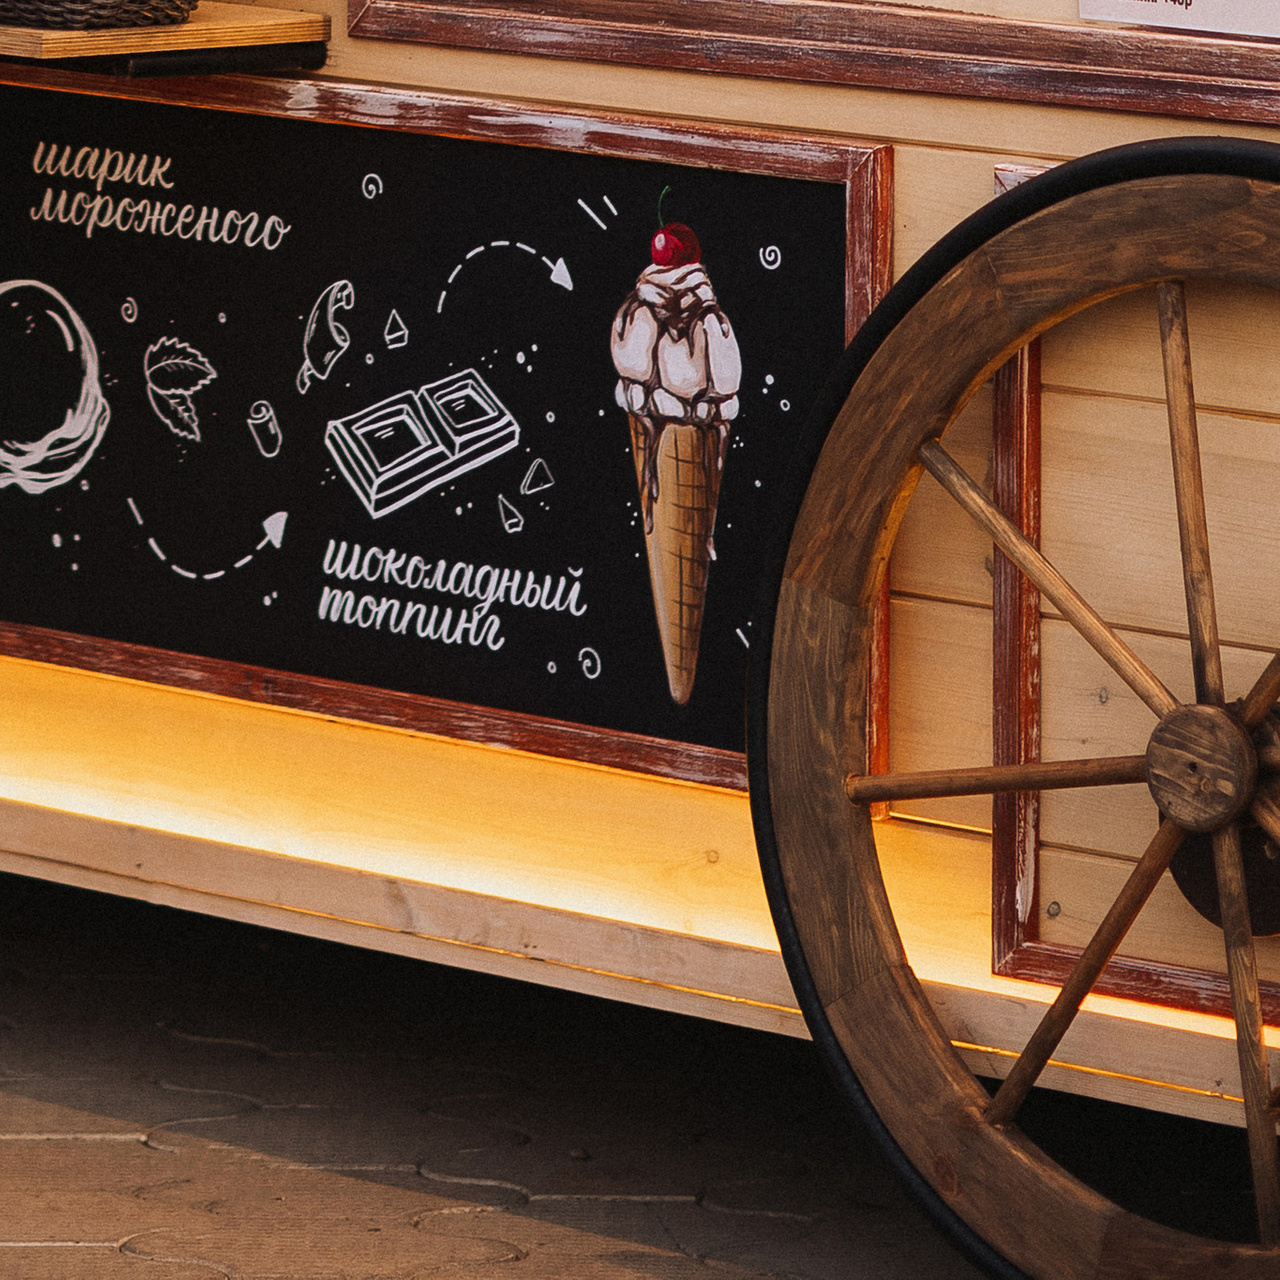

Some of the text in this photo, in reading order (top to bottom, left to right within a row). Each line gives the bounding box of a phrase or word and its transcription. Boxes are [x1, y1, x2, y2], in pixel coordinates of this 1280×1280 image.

[32, 141, 175, 192] шарик
[30, 187, 292, 250] мороженого
[322, 538, 588, 618] шоколадный
[318, 586, 505, 651] топпинг
